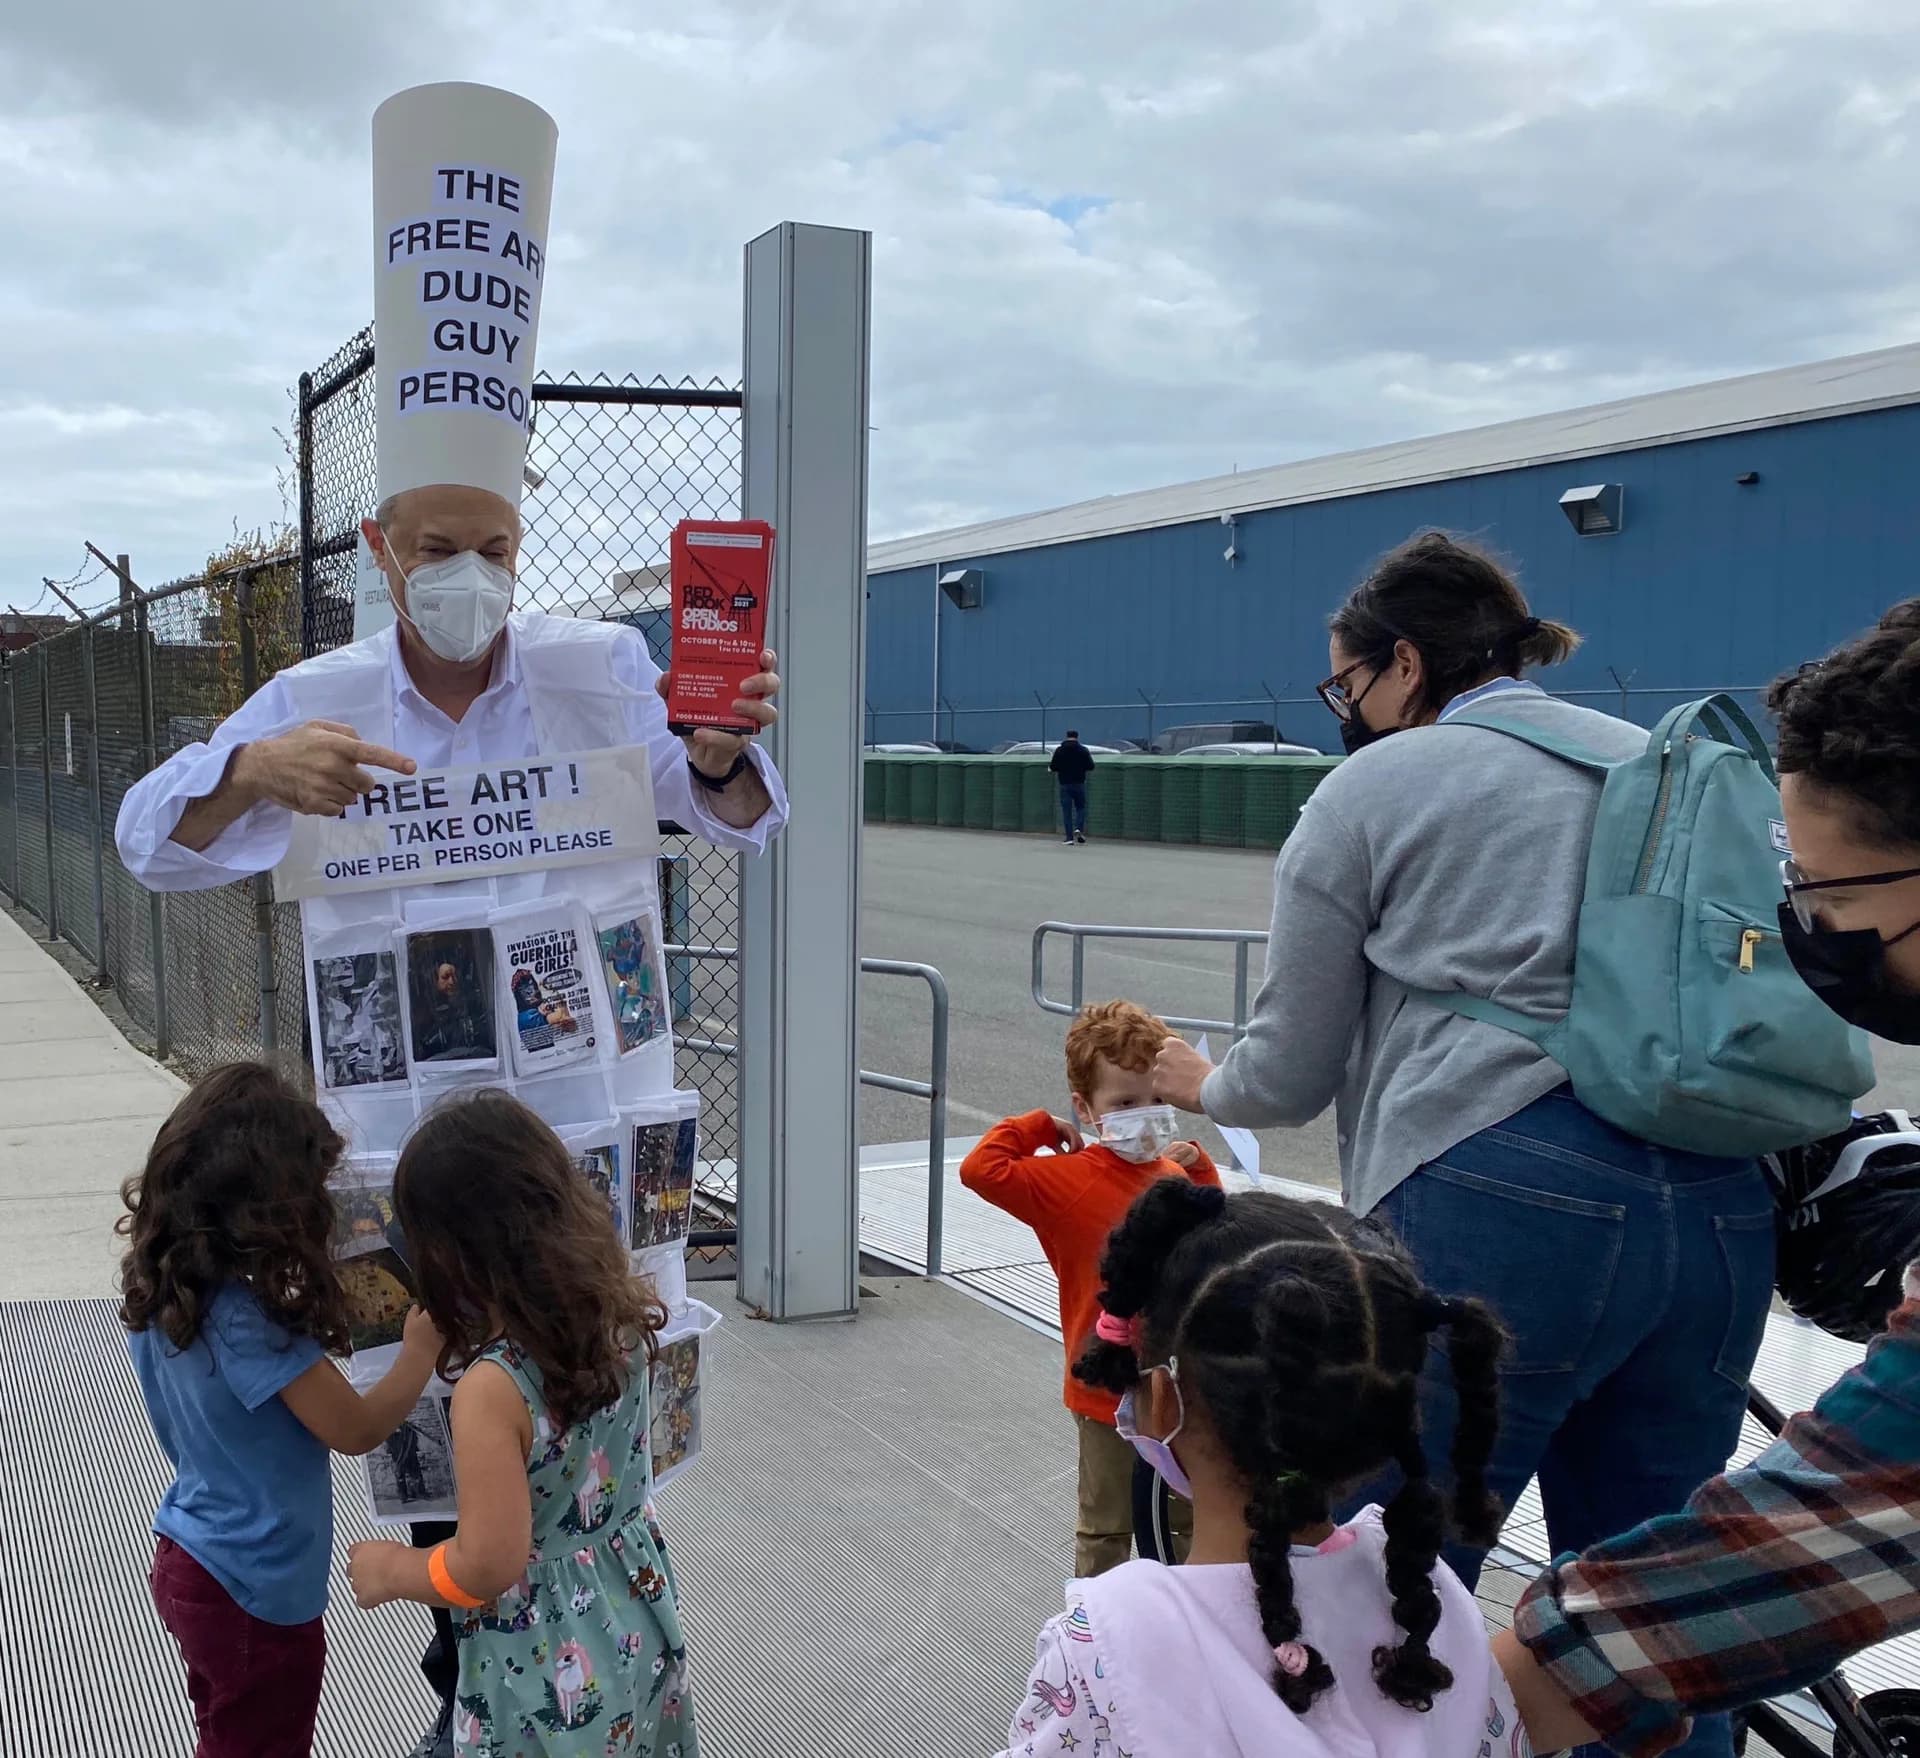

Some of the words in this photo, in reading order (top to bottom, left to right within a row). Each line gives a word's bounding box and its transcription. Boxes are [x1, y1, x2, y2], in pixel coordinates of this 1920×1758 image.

[438, 169, 520, 213] THE
[388, 219, 490, 264] FREE
[423, 270, 531, 324] DUDE
[434, 319, 520, 364] GUY
[683, 585, 713, 598] RED
[681, 618, 738, 632] STUDIOS
[682, 607, 718, 620] OPEN
[680, 637, 718, 645] OCTOBER
[470, 766, 553, 806] ART
[389, 817, 465, 846] TAKE
[473, 809, 534, 837] ONE
[324, 859, 372, 879] ONE
[377, 854, 421, 874] PER
[435, 840, 523, 867] PERSON
[530, 830, 613, 854] PLEASE
[507, 937, 546, 953] INVASION
[548, 933, 559, 943] OF
[560, 929, 576, 939] THE
[510, 938, 578, 967] GUERRILLA
[535, 950, 574, 974] GIRLS!
